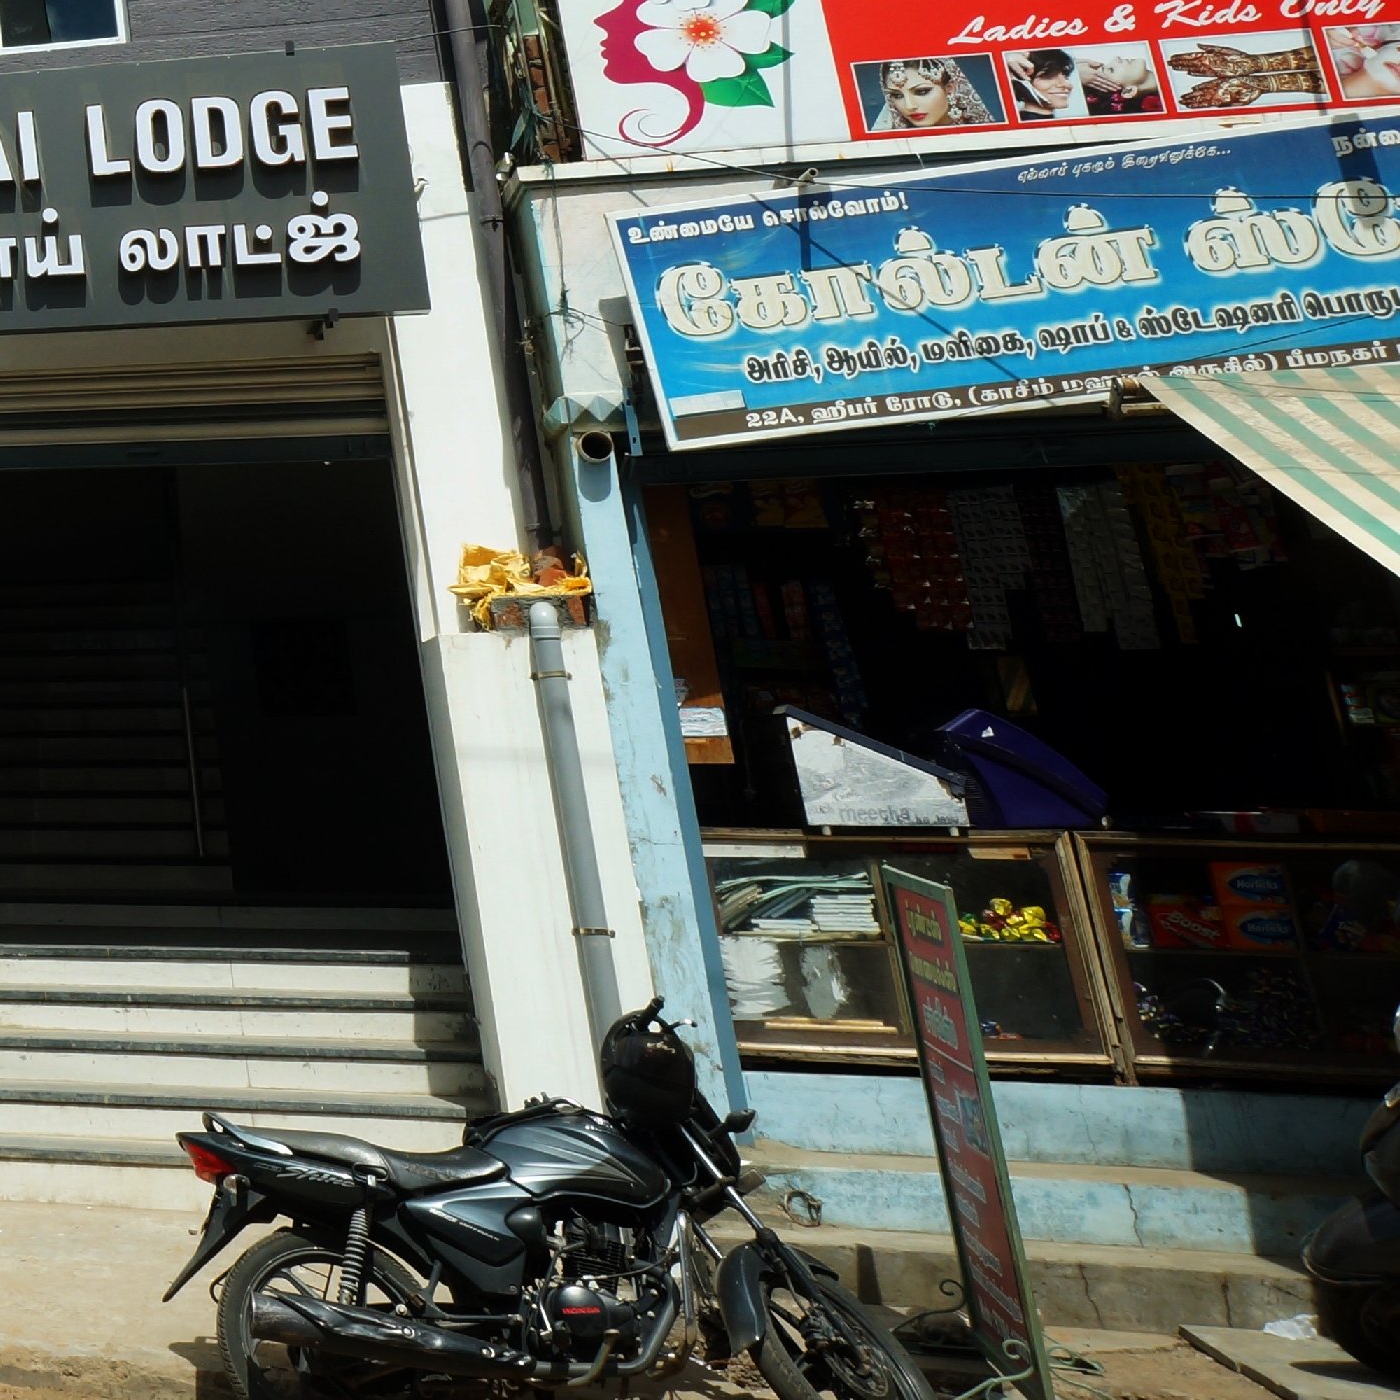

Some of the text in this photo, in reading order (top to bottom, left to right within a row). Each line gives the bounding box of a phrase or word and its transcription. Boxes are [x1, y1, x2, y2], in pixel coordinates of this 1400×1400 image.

[947, 15, 1089, 45] Ladies
[1103, 4, 1136, 33] &
[1154, 0, 1262, 29] Kids
[85, 86, 360, 176] LODGE
[119, 190, 361, 272] லாட்ஜ்
[628, 214, 755, 245] உண்மையே
[656, 202, 1159, 338] கோல்டன்
[747, 349, 822, 383] அரிசி,
[826, 338, 920, 378] ஆயில்,
[922, 329, 1036, 362] மளிகை,
[1039, 312, 1111, 353] ஷாப்
[1116, 319, 1134, 340] &
[1139, 290, 1302, 337] ஸ்டேஷனரி
[746, 408, 805, 428] 22A,
[886, 390, 961, 415] ரோடு,
